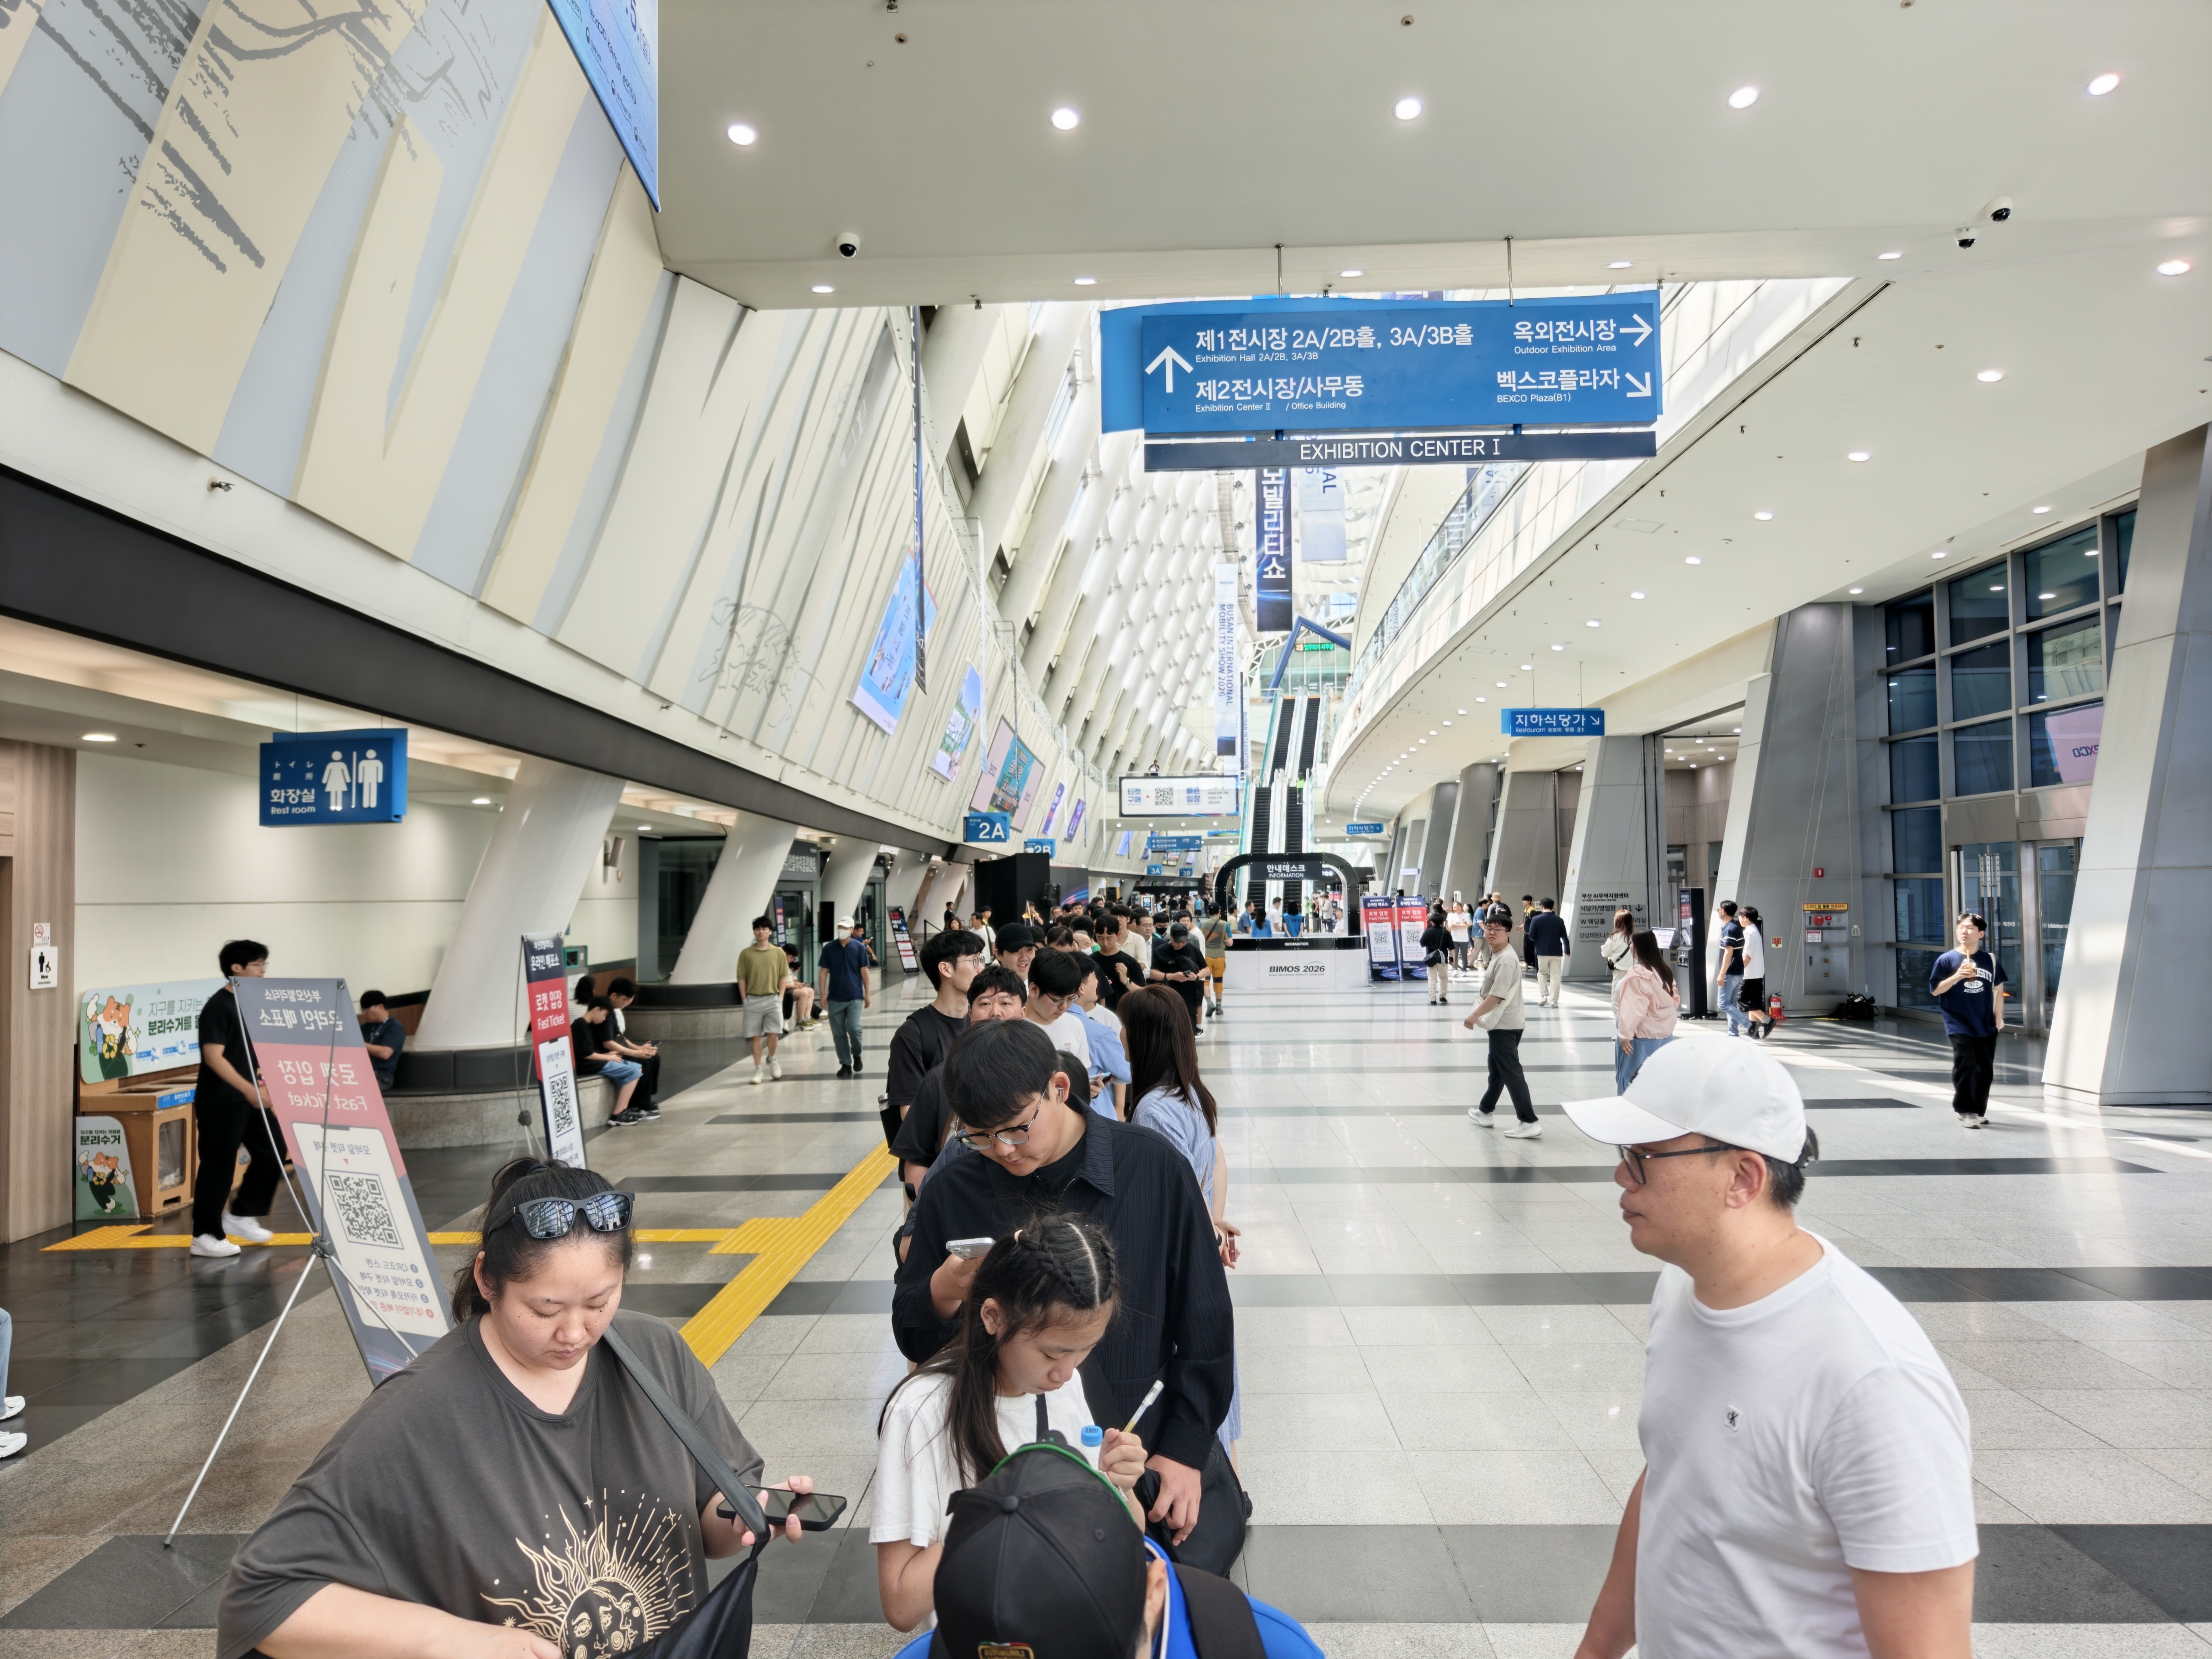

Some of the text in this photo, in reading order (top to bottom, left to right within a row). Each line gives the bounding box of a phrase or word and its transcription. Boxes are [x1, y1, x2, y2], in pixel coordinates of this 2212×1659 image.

[1196, 323, 1474, 351] 제1전시장 2A/2B홀, 3A/3B홀
[1513, 319, 1616, 343] 옥외전시장
[1195, 351, 1319, 363] Exhibition Hall 2A/2B, 3A/3B
[1514, 346, 1549, 354] Outdoor
[1552, 344, 1593, 353] Exhibition
[1195, 376, 1364, 401] 제2전시장/사무동
[1497, 368, 1620, 392] 벡스코플라자
[1195, 403, 1233, 412] Exhibition
[1236, 403, 1264, 412] Center
[1292, 402, 1314, 410] Office
[1316, 400, 1346, 410] Building
[1497, 392, 1571, 403] BEXCO Plaza(B1)
[1300, 438, 1500, 460] EXHIBITION CENTER I
[1515, 714, 1586, 727] 지하식당가
[270, 789, 315, 804] 화장실
[271, 806, 316, 815] Rest room
[979, 822, 1005, 839] 2A
[1034, 845, 1051, 855] 2B
[530, 953, 560, 972] 온라인 매표소
[148, 997, 203, 1017] 지구를 지키는
[535, 990, 562, 1012] 로켓 입장
[148, 1015, 192, 1036] 분리수거를
[537, 1012, 565, 1031] Fast Ticket
[80, 1135, 121, 1145] 분리수거
